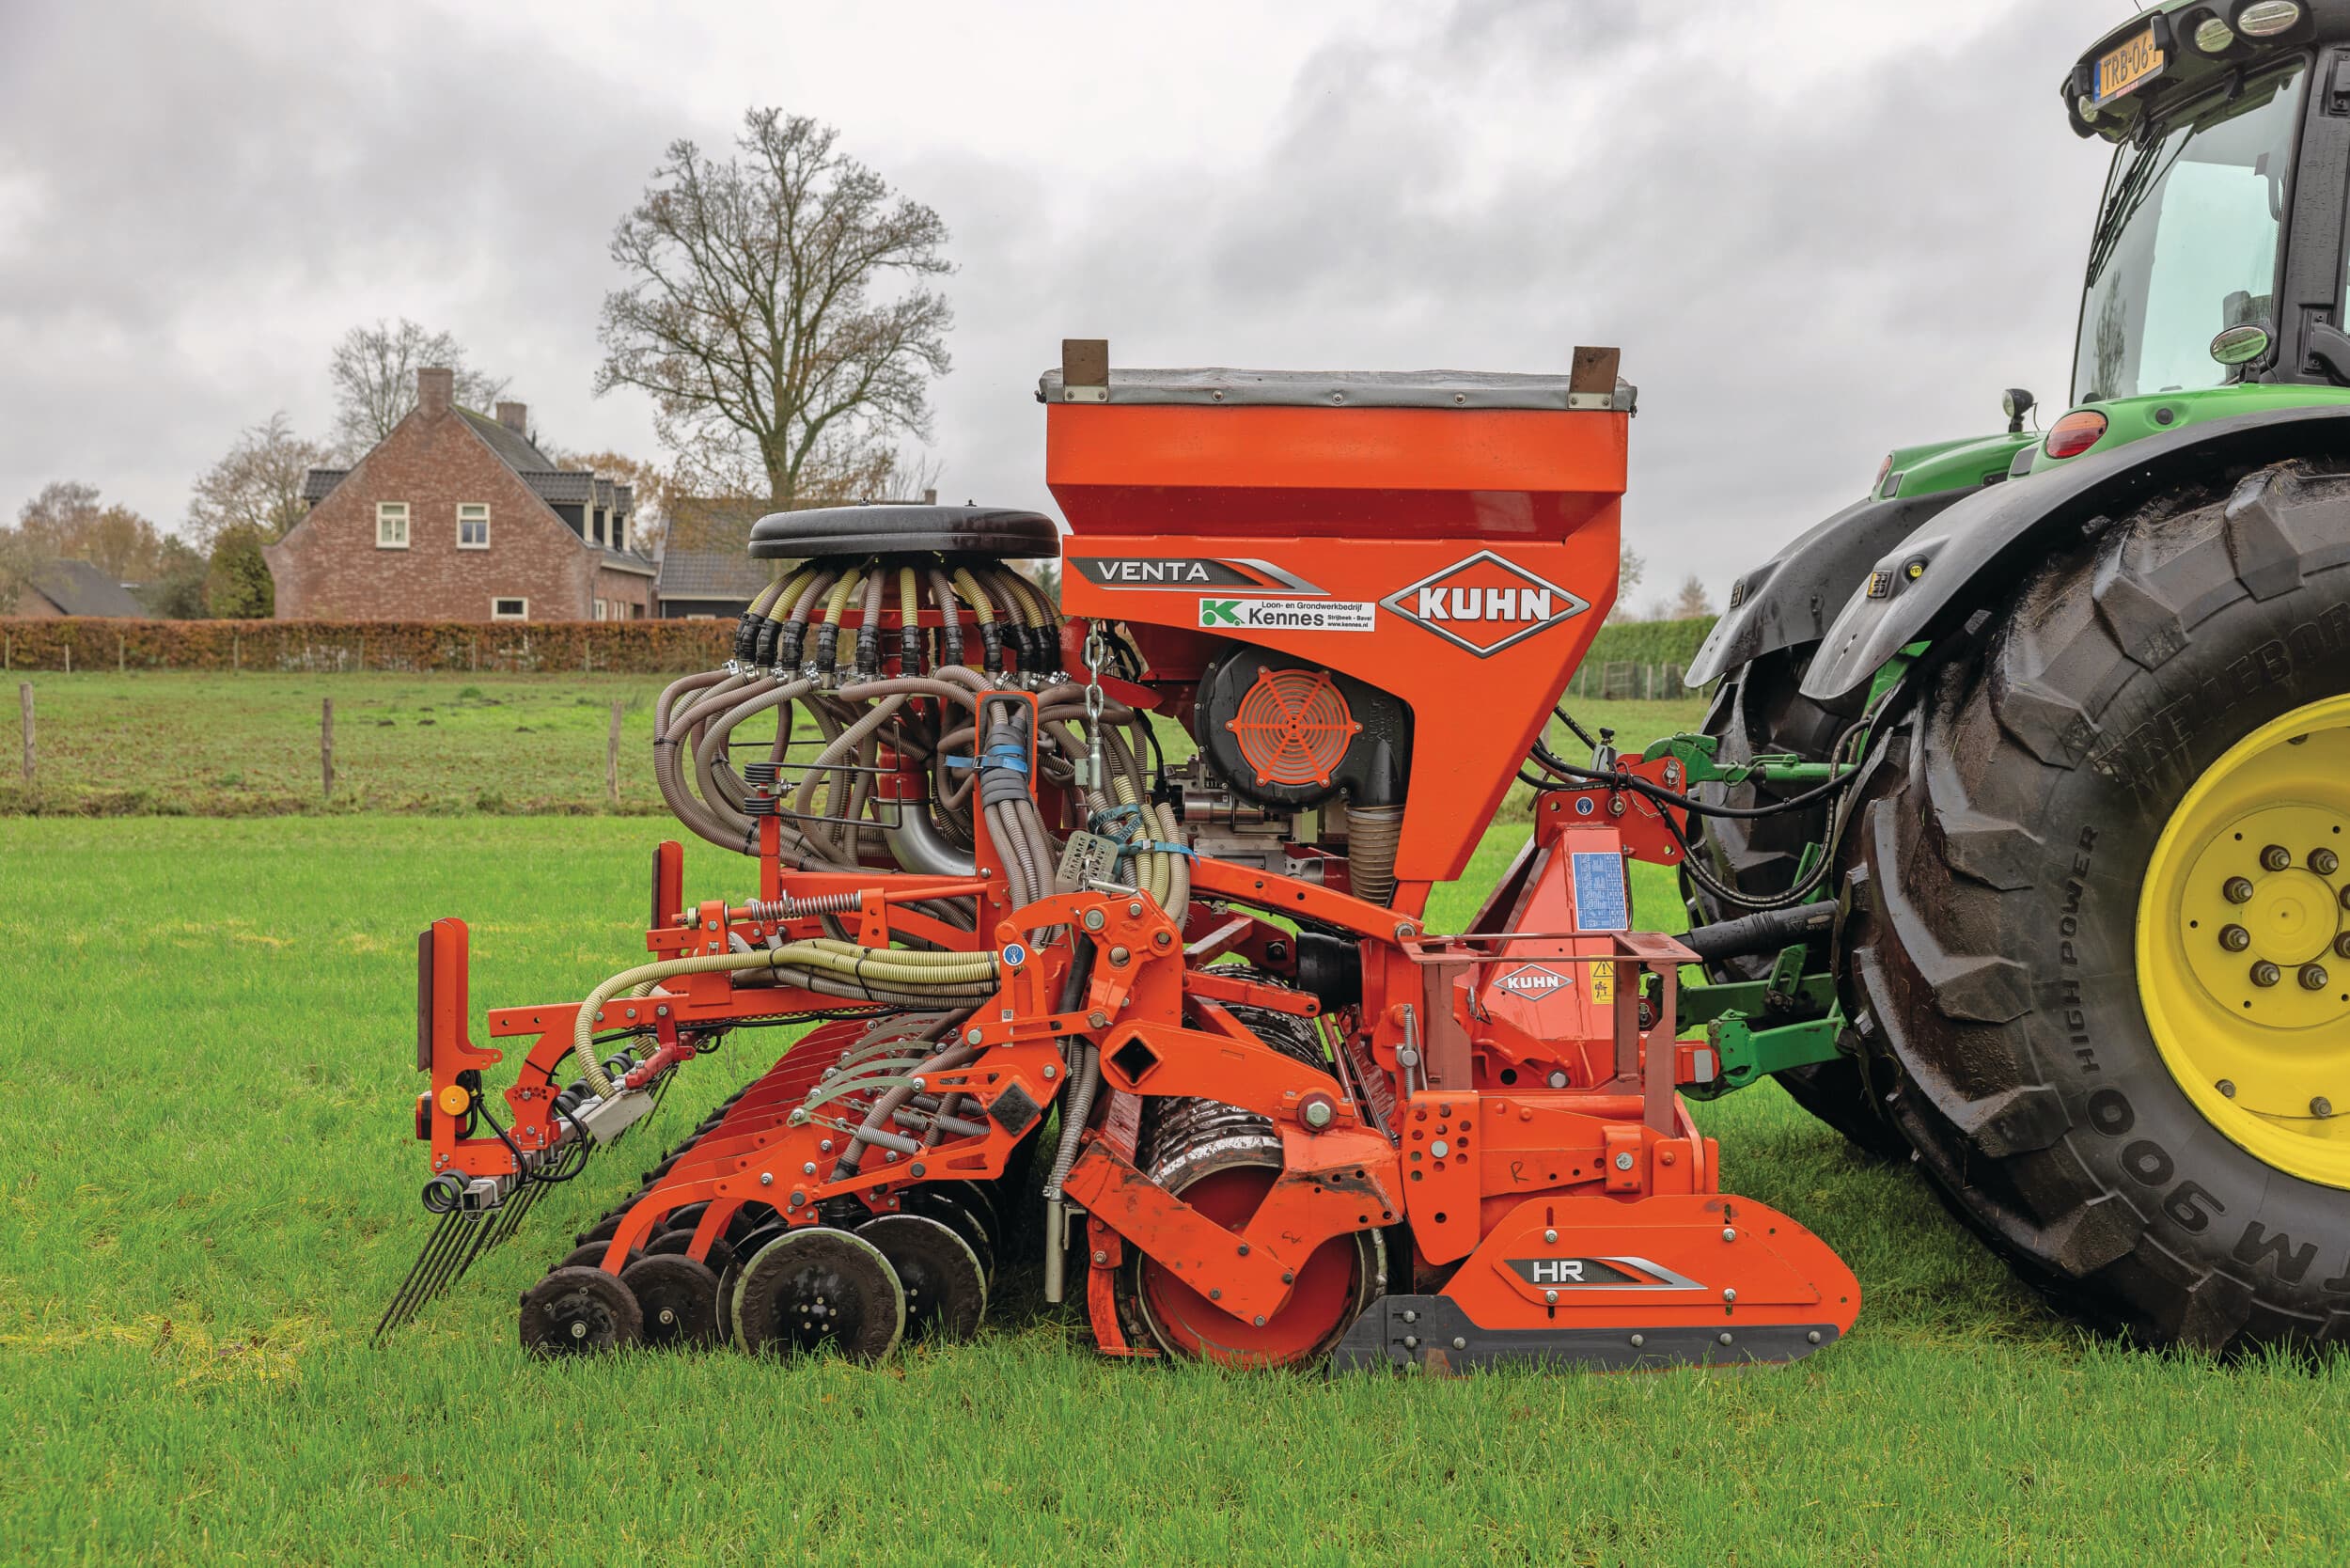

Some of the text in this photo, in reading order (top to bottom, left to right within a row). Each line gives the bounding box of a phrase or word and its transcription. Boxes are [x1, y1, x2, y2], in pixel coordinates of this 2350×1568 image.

[1096, 560, 1211, 582] VENTA
[1261, 601, 1284, 609] Loon-
[1296, 602, 1363, 612] Grondwerkbedrijf
[1417, 586, 1552, 622] KUHN
[1248, 607, 1324, 627] Kennes
[2060, 824, 2101, 1074] HIGH POWER
[1507, 976, 1559, 989] KUHN
[1532, 1261, 1586, 1283] HR
